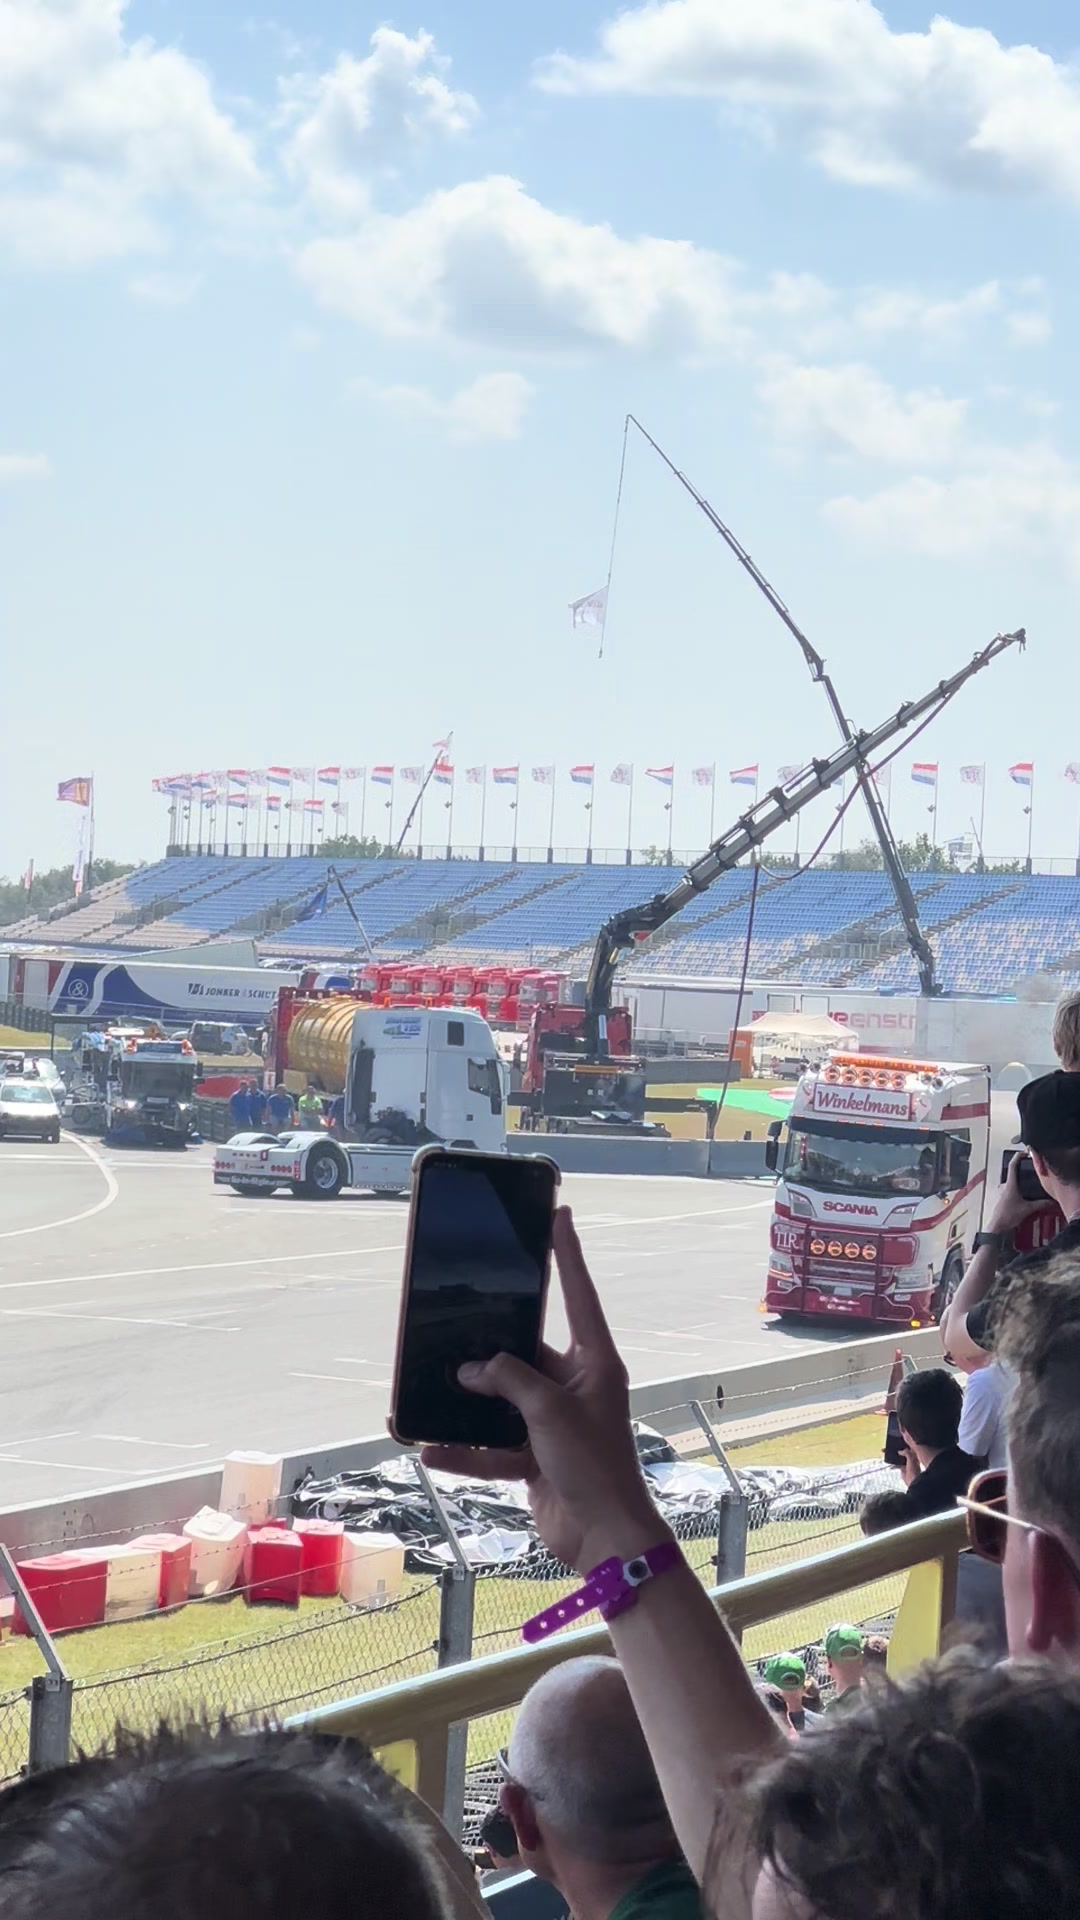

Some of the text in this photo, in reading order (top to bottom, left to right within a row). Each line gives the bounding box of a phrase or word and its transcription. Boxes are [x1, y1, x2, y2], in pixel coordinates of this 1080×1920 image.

[205, 987, 241, 997] JONKER
[829, 1011, 916, 1031] eenstr
[817, 1090, 909, 1116] Winkelmans
[822, 1200, 879, 1216] SCANIA
[774, 1231, 800, 1250] TIR
